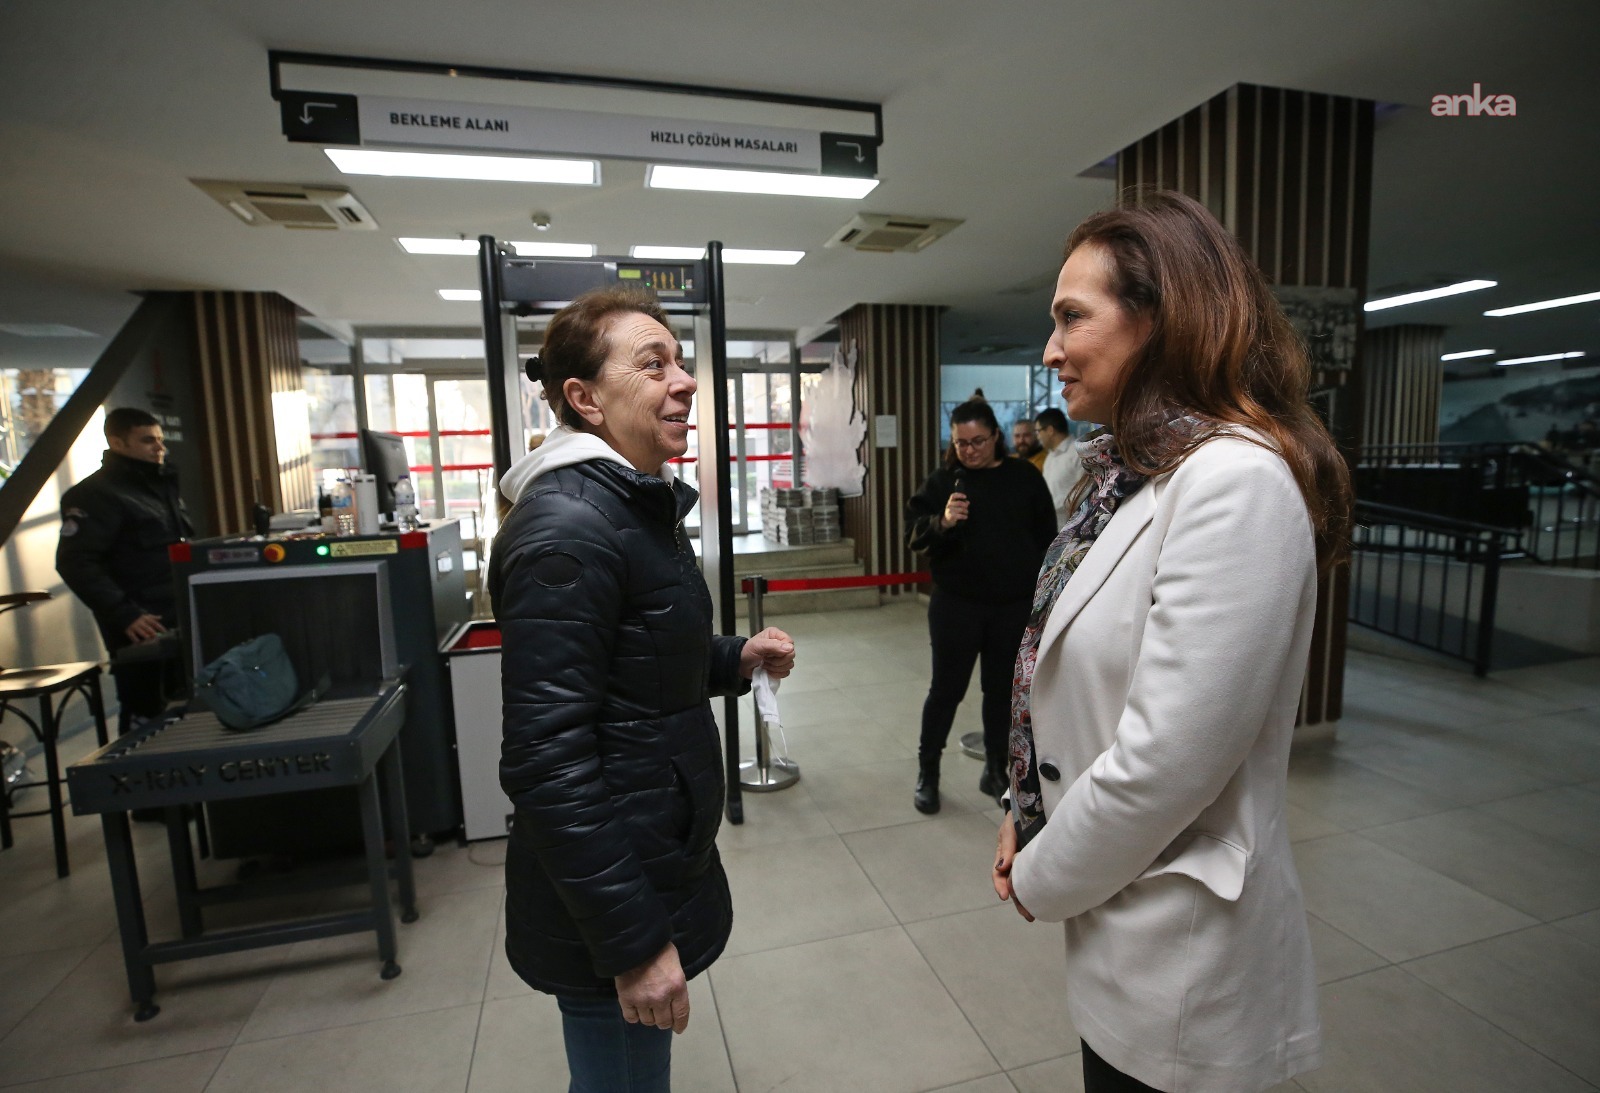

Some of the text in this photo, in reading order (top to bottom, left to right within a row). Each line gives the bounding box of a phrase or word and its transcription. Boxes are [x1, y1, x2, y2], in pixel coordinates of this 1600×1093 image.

[389, 112, 509, 132] BEKLEME ALANI
[650, 131, 798, 153] HIZLI ÇÖZÜM MASALARI
[110, 752, 332, 794] X-RAY CENTER
